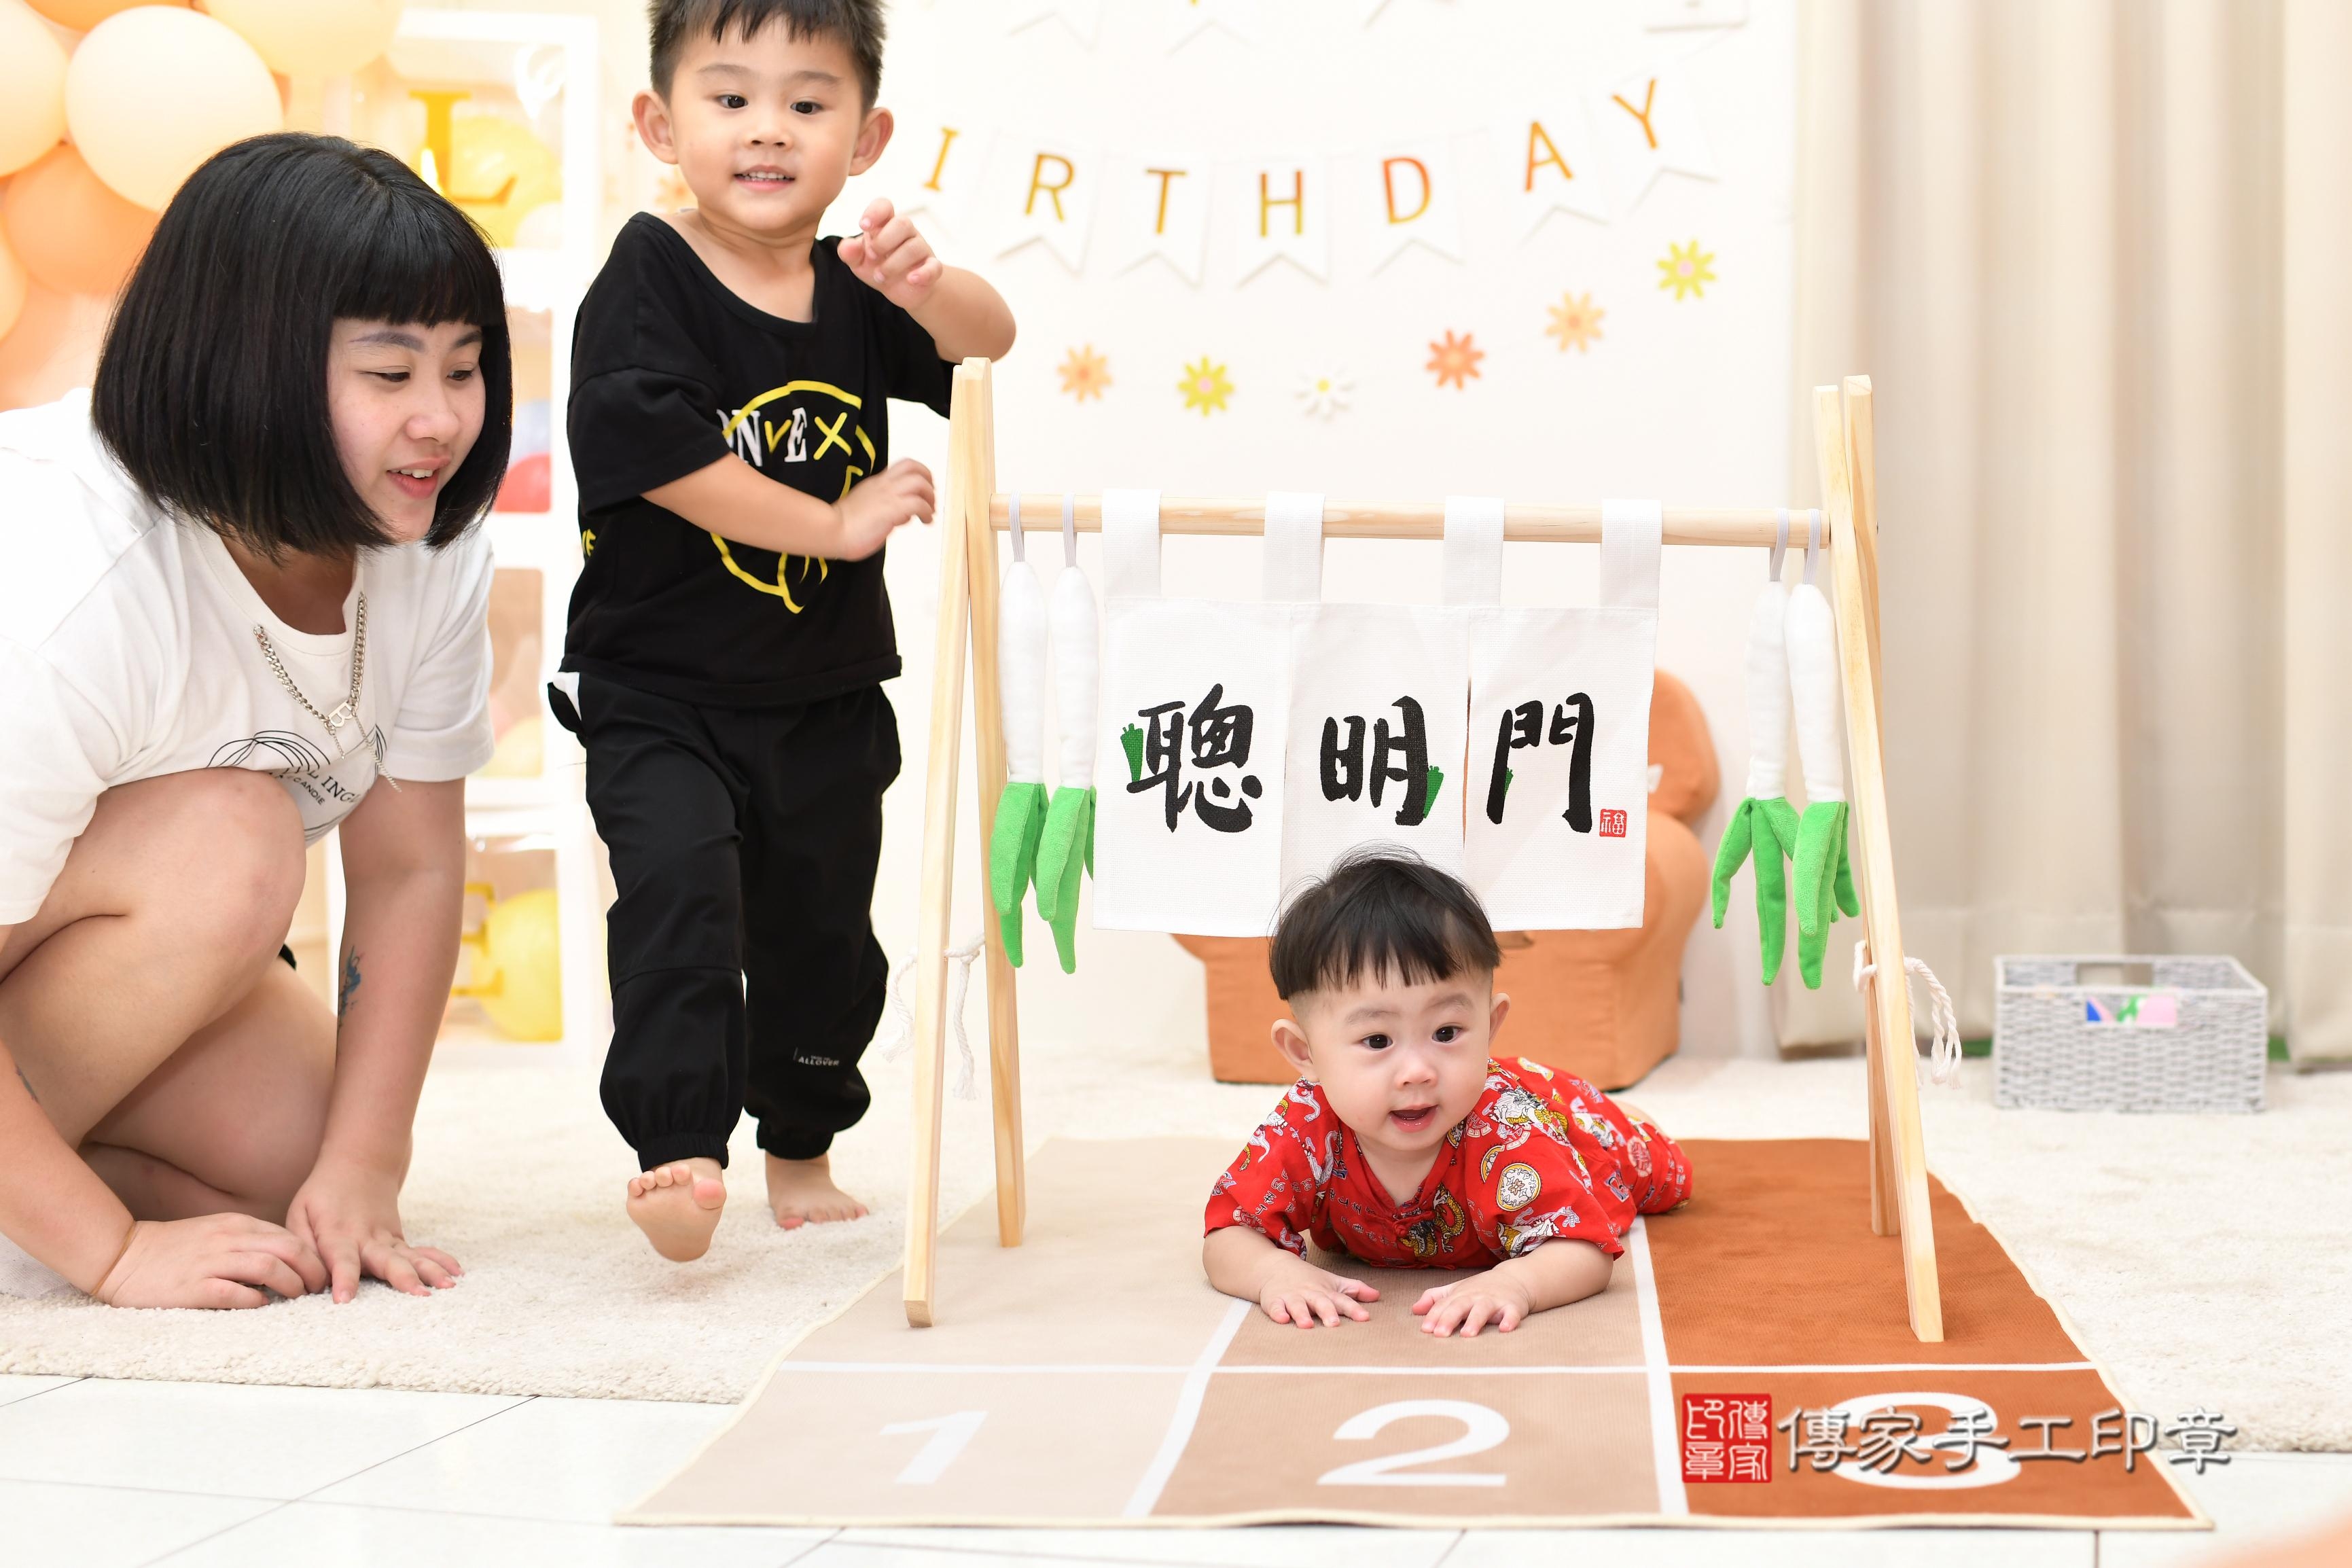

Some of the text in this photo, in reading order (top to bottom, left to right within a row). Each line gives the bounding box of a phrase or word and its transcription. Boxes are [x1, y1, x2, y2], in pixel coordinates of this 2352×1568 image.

[410, 90, 517, 203] L
[923, 78, 1658, 238] IRTHDAY
[1126, 683, 1594, 833] 聰明門
[878, 1410, 988, 1484] 1
[1316, 1398, 1510, 1486] 2
